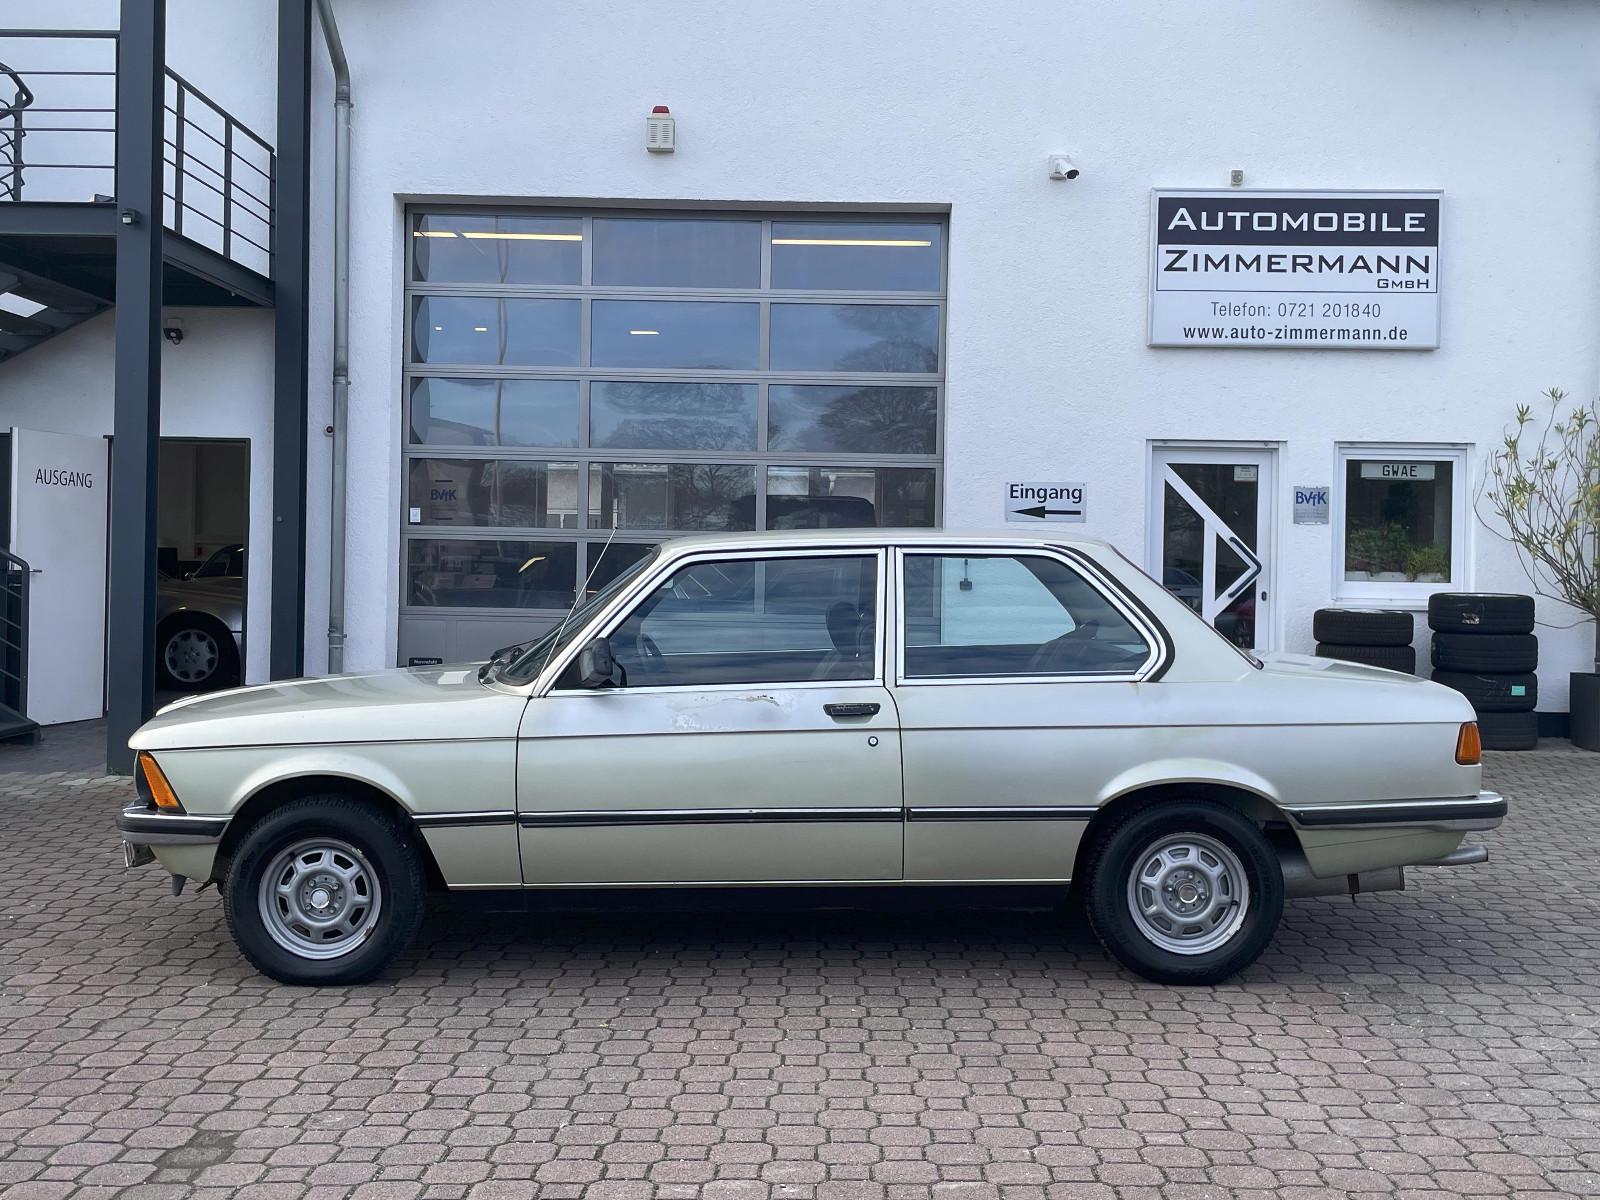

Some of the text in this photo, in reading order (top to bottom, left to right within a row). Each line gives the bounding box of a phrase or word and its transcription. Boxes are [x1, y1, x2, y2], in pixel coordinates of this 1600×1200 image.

[1167, 207, 1426, 232] AUTOMOBILE
[1163, 250, 1430, 274] ZIMMERMANN
[1211, 301, 1381, 318] Telefon: 0721 201840
[1183, 326, 1408, 341] www.auto-zimmermann.de
[35, 468, 93, 489] AUSGANG
[1382, 464, 1418, 477] GWAE
[1009, 483, 1083, 504] Eingang
[1295, 491, 1327, 506] BVfK
